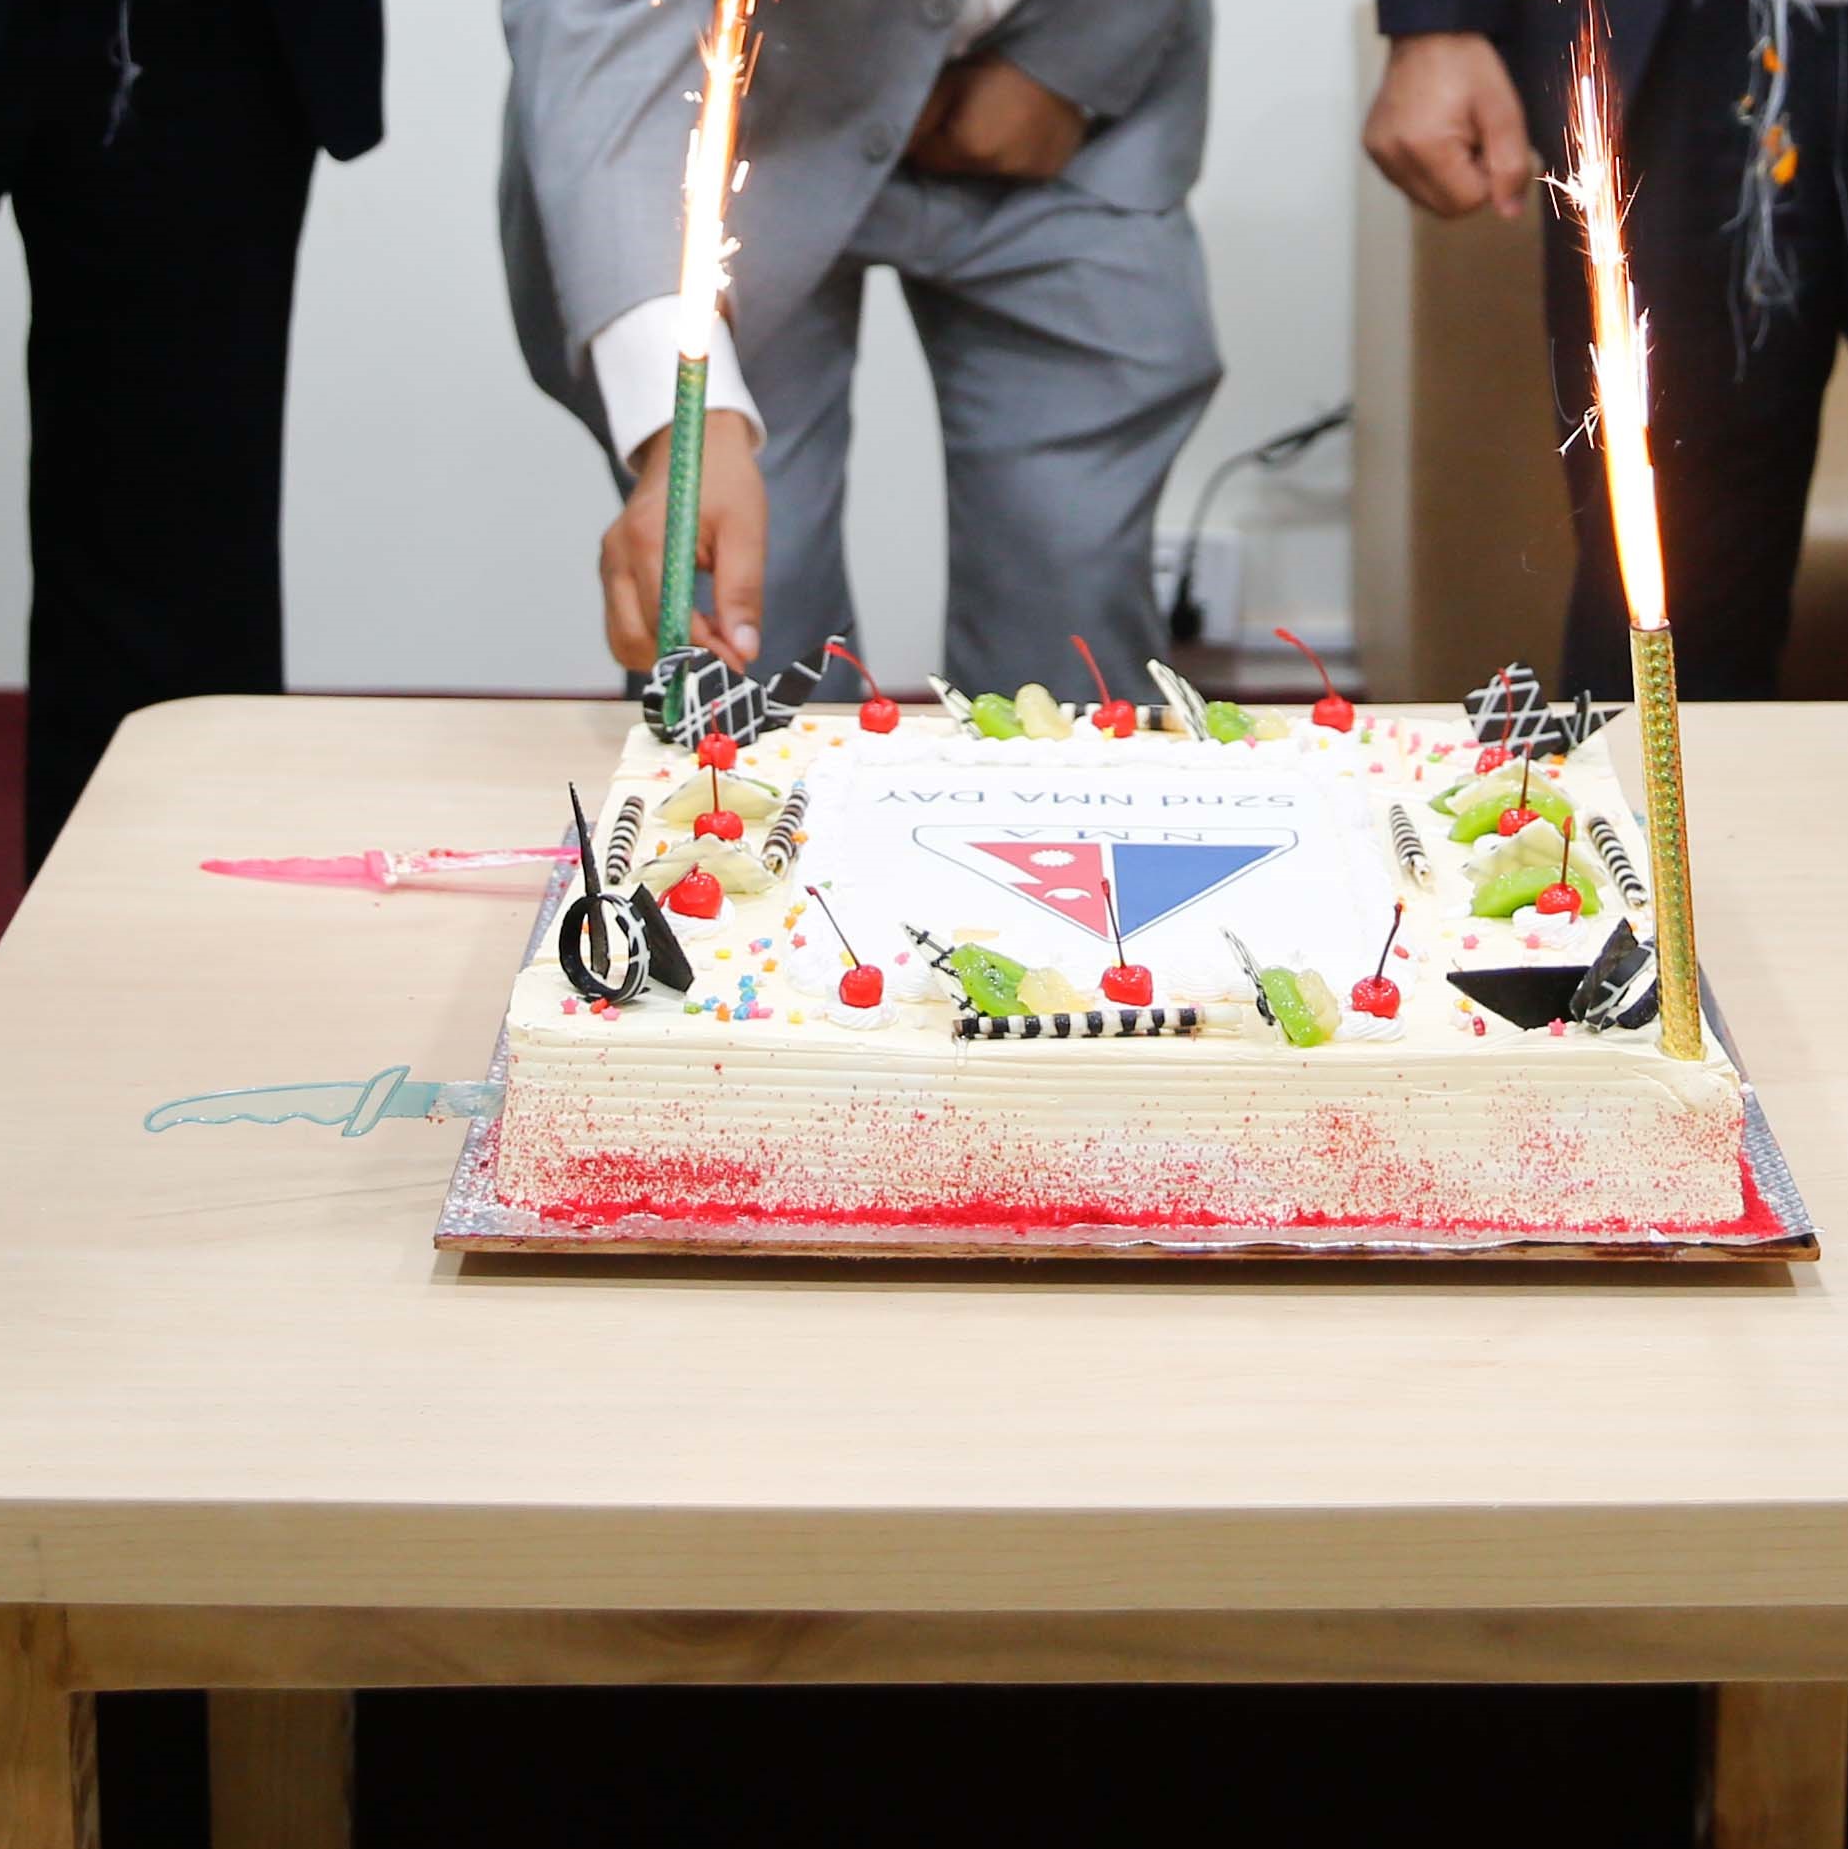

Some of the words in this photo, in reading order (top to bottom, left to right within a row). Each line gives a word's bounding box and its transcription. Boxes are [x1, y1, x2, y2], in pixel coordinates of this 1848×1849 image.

[875, 789, 986, 804] DAY
[1012, 790, 1134, 807] NMA
[1161, 793, 1296, 808] 52nd
